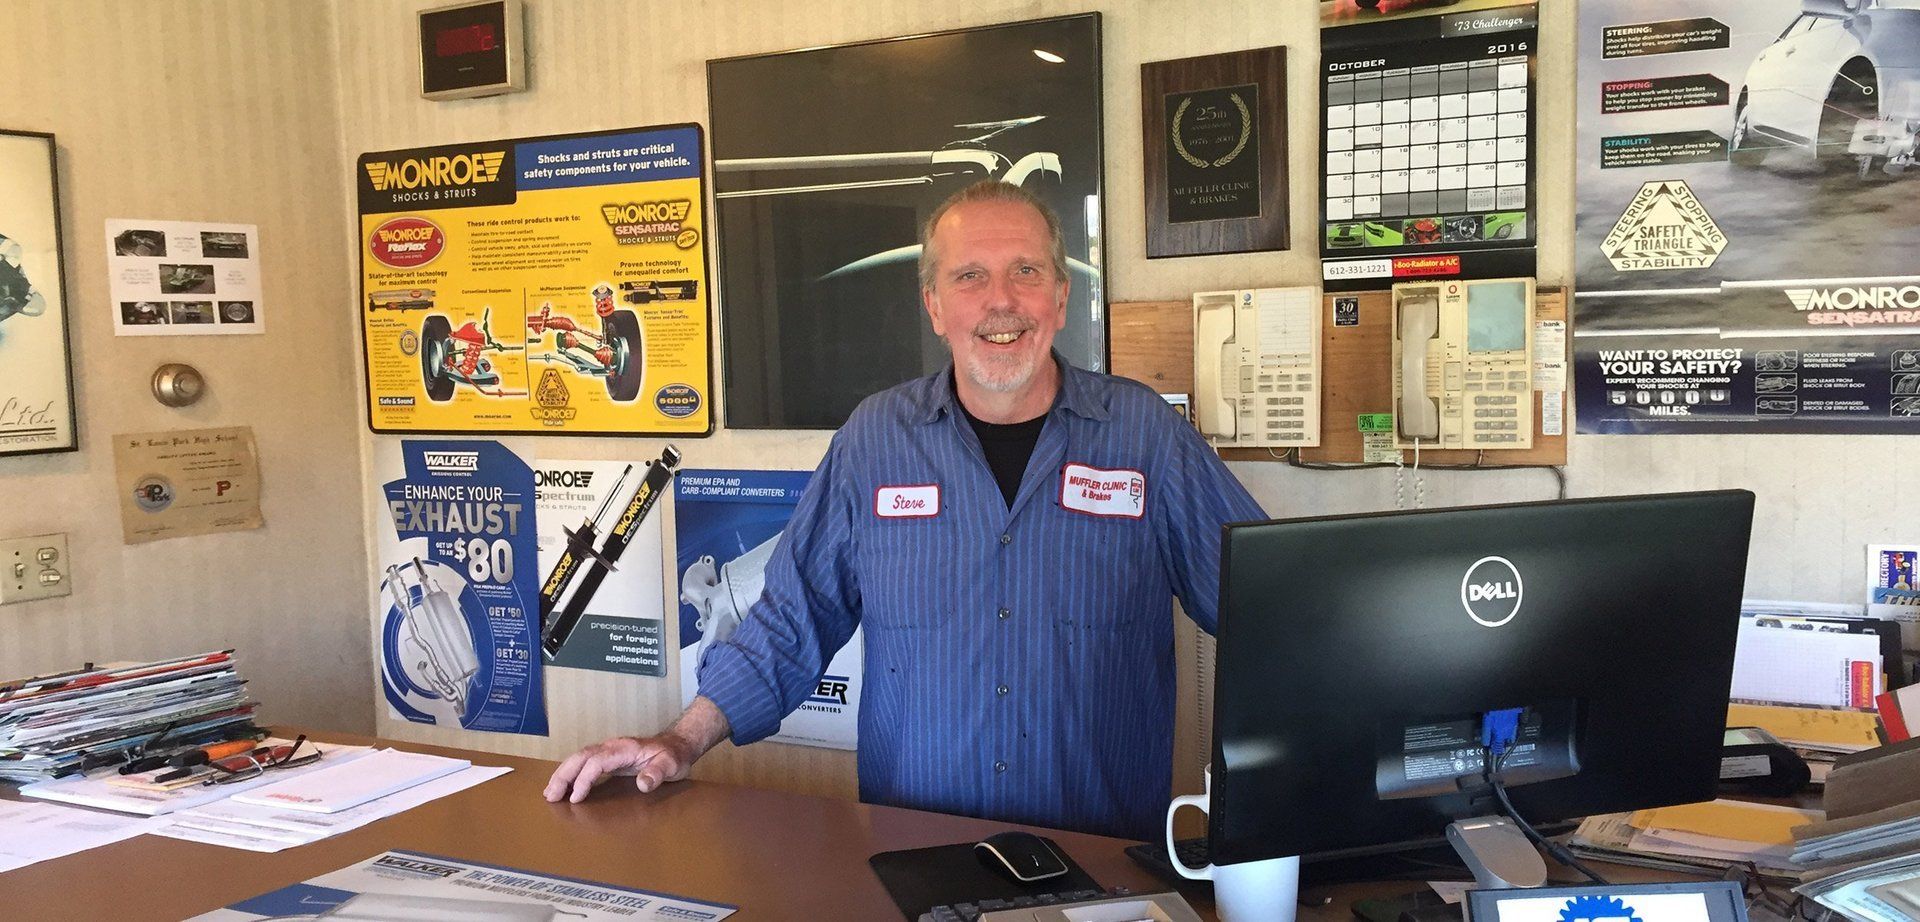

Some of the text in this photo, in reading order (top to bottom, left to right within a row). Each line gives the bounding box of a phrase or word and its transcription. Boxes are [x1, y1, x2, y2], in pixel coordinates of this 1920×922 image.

[1472, 17, 1524, 29] Challenger
[1606, 27, 1652, 37] STEERING:
[1488, 43, 1528, 54] 2016
[1606, 82, 1652, 92] STOPPING:
[1196, 106, 1226, 121] 25th
[1604, 138, 1651, 147] STABILITY:
[538, 154, 570, 164] Shocks
[573, 152, 590, 161] and
[592, 150, 620, 159] struts
[641, 144, 674, 155] critical
[379, 152, 495, 190] MONROE
[524, 157, 690, 179] safety components for your vehicle.
[1174, 184, 1219, 195] MUFFLER
[393, 188, 477, 204] SHOCKS & STRUTS
[1198, 194, 1238, 204] BRAKES
[609, 202, 685, 224] MONROE
[1606, 188, 1653, 247] STEERING
[1674, 186, 1722, 244] STOPPING
[525, 217, 552, 226] products
[384, 228, 430, 243] MONROE
[1640, 225, 1686, 238] SAFETY
[618, 236, 645, 245] SHOCKS
[654, 235, 676, 243] STRUTS
[1634, 238, 1692, 250] TRIANGLE
[620, 260, 681, 269] Proven technology
[1446, 258, 1458, 266] A/C
[1622, 257, 1707, 268] STABILITY
[369, 271, 447, 280] State-of-the-art technology
[624, 268, 661, 277] unequalled
[663, 267, 689, 275] comfort
[1329, 265, 1386, 275] 612-331-1221
[1800, 285, 1920, 311] MONRO
[1340, 302, 1354, 313] 30
[1598, 348, 1743, 361] WANT TO PROTECT
[1599, 360, 1742, 375] YOUR SAFETY?
[532, 408, 572, 420] MONROE
[0, 436, 57, 445] STORATION
[172, 438, 188, 447] Park
[194, 436, 210, 444] High
[216, 435, 238, 443] School
[425, 453, 479, 472] WALKER
[535, 470, 588, 488] ONROE
[681, 477, 740, 486] PREMIUM EPA AND
[1069, 476, 1128, 491] MUFFLER CLINIC
[216, 480, 231, 496] P
[405, 485, 503, 502] ENHANCE YOUR
[681, 487, 785, 497] CARB-COMPLIANT CONVERTERS
[535, 491, 600, 502] Spectrum
[1082, 489, 1112, 501] & Brakes
[893, 494, 925, 510] Steve
[616, 484, 650, 534] MONROE
[390, 501, 522, 535] EXHAUST
[454, 537, 514, 584] $80
[546, 554, 572, 594] MONROE
[1881, 553, 1890, 588] IRECTORY
[1468, 581, 1516, 600] DELL
[489, 606, 521, 618] GET $50
[591, 622, 658, 634] precision-tuned
[610, 633, 658, 645] for foreign
[496, 648, 528, 660] GET $30
[612, 645, 658, 655] nameplate
[606, 654, 659, 666] applications
[377, 855, 460, 878] WALKER
[465, 870, 652, 909] THE POWER OF STAINLESS STEEL
